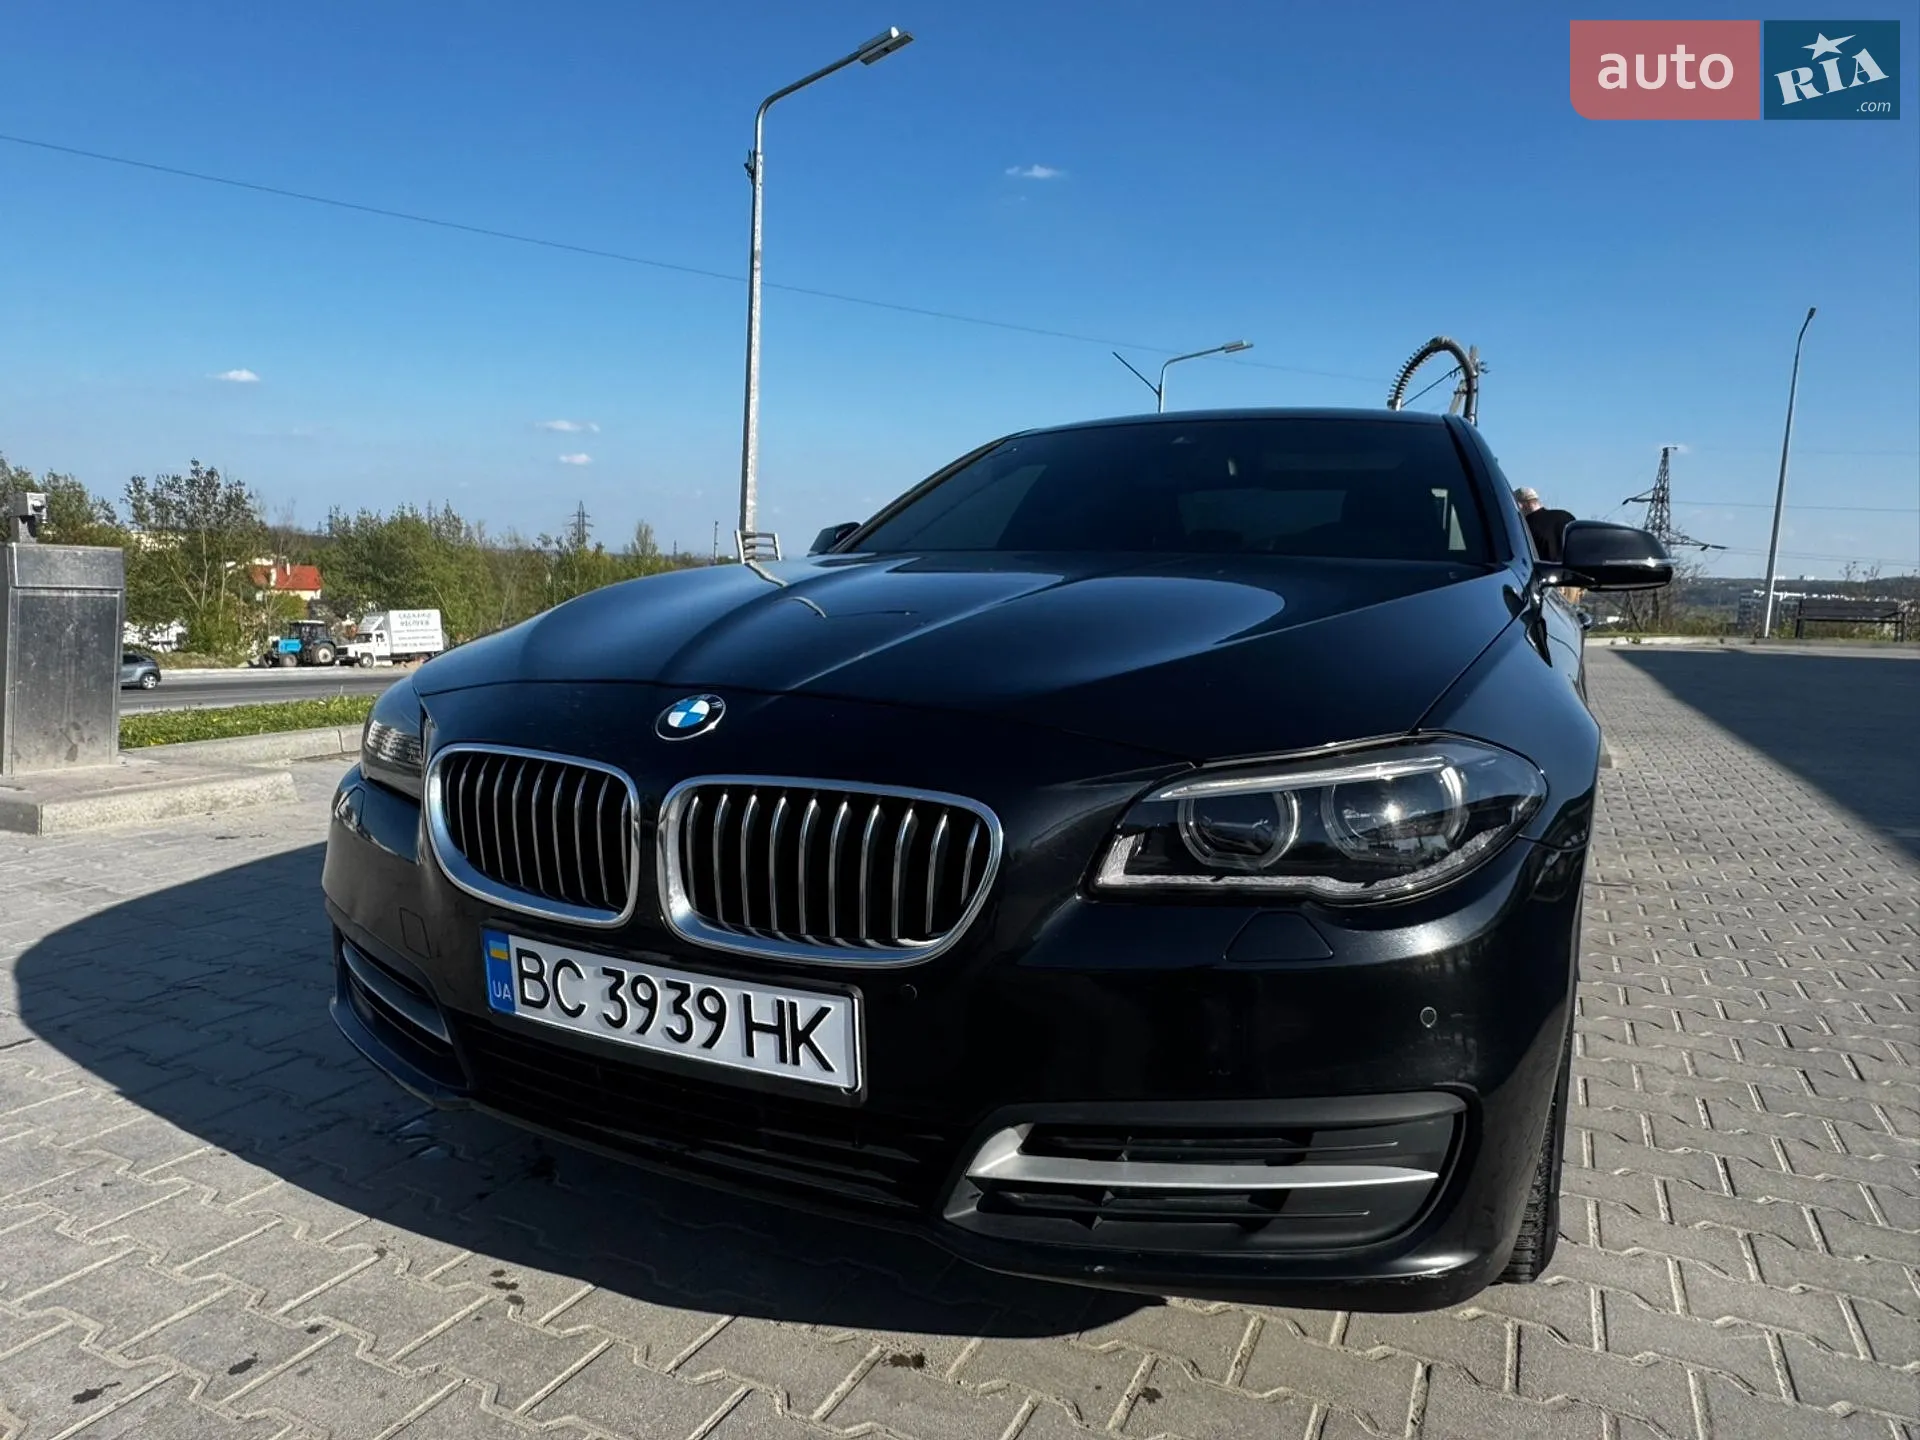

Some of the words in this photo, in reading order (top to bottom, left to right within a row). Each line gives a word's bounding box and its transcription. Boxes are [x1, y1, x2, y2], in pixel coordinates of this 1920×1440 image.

[492, 980, 512, 1001] UA
[516, 947, 588, 1018] BC
[601, 966, 728, 1050] 3939
[740, 992, 837, 1073] HK
